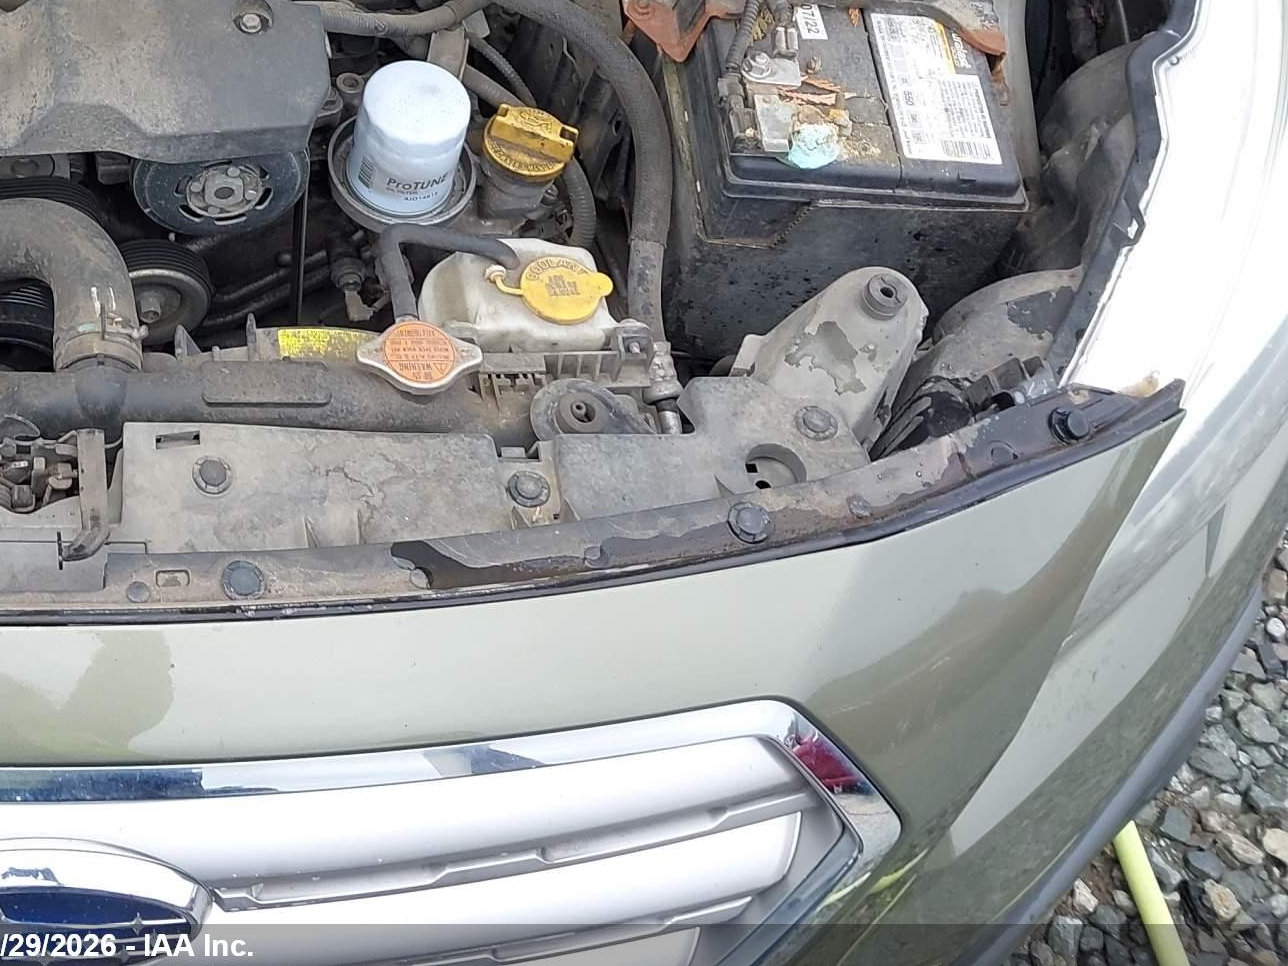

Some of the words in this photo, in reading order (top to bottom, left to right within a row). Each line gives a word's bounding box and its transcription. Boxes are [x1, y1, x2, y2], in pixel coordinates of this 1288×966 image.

[951, 33, 972, 69] uralast
[385, 172, 449, 191] ProTUNE
[398, 362, 433, 371] WARNING
